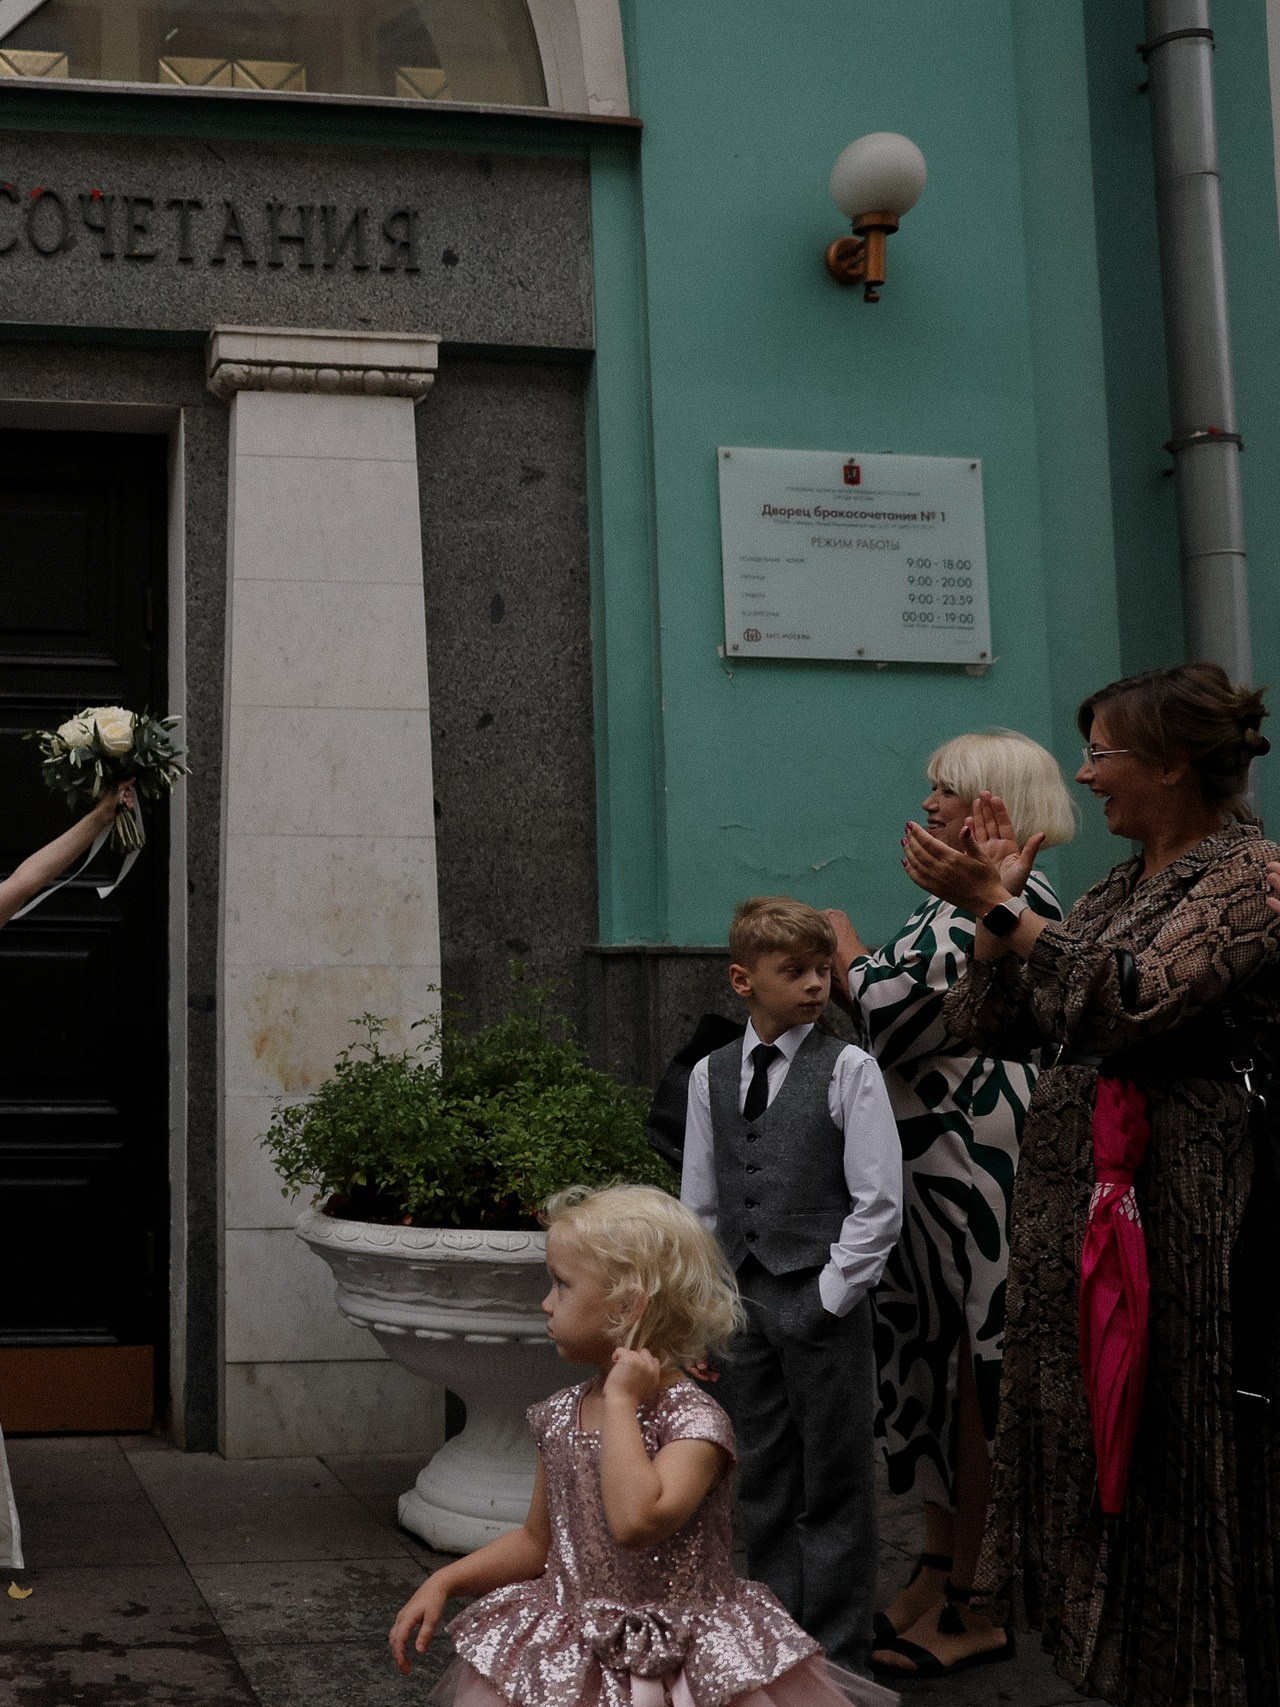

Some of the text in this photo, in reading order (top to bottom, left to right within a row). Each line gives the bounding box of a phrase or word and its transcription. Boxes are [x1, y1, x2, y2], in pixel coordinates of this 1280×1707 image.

[762, 505, 946, 522] Дворец бракосочетания № 1
[811, 537, 900, 551] РЕЖИМ РАБОТЫ
[907, 558, 931, 569] 9:00
[907, 575, 932, 587] 9:00
[941, 576, 972, 588] 20:00
[908, 593, 933, 605] 9:00
[902, 611, 934, 623] 00:00
[944, 612, 974, 624] 19:00
